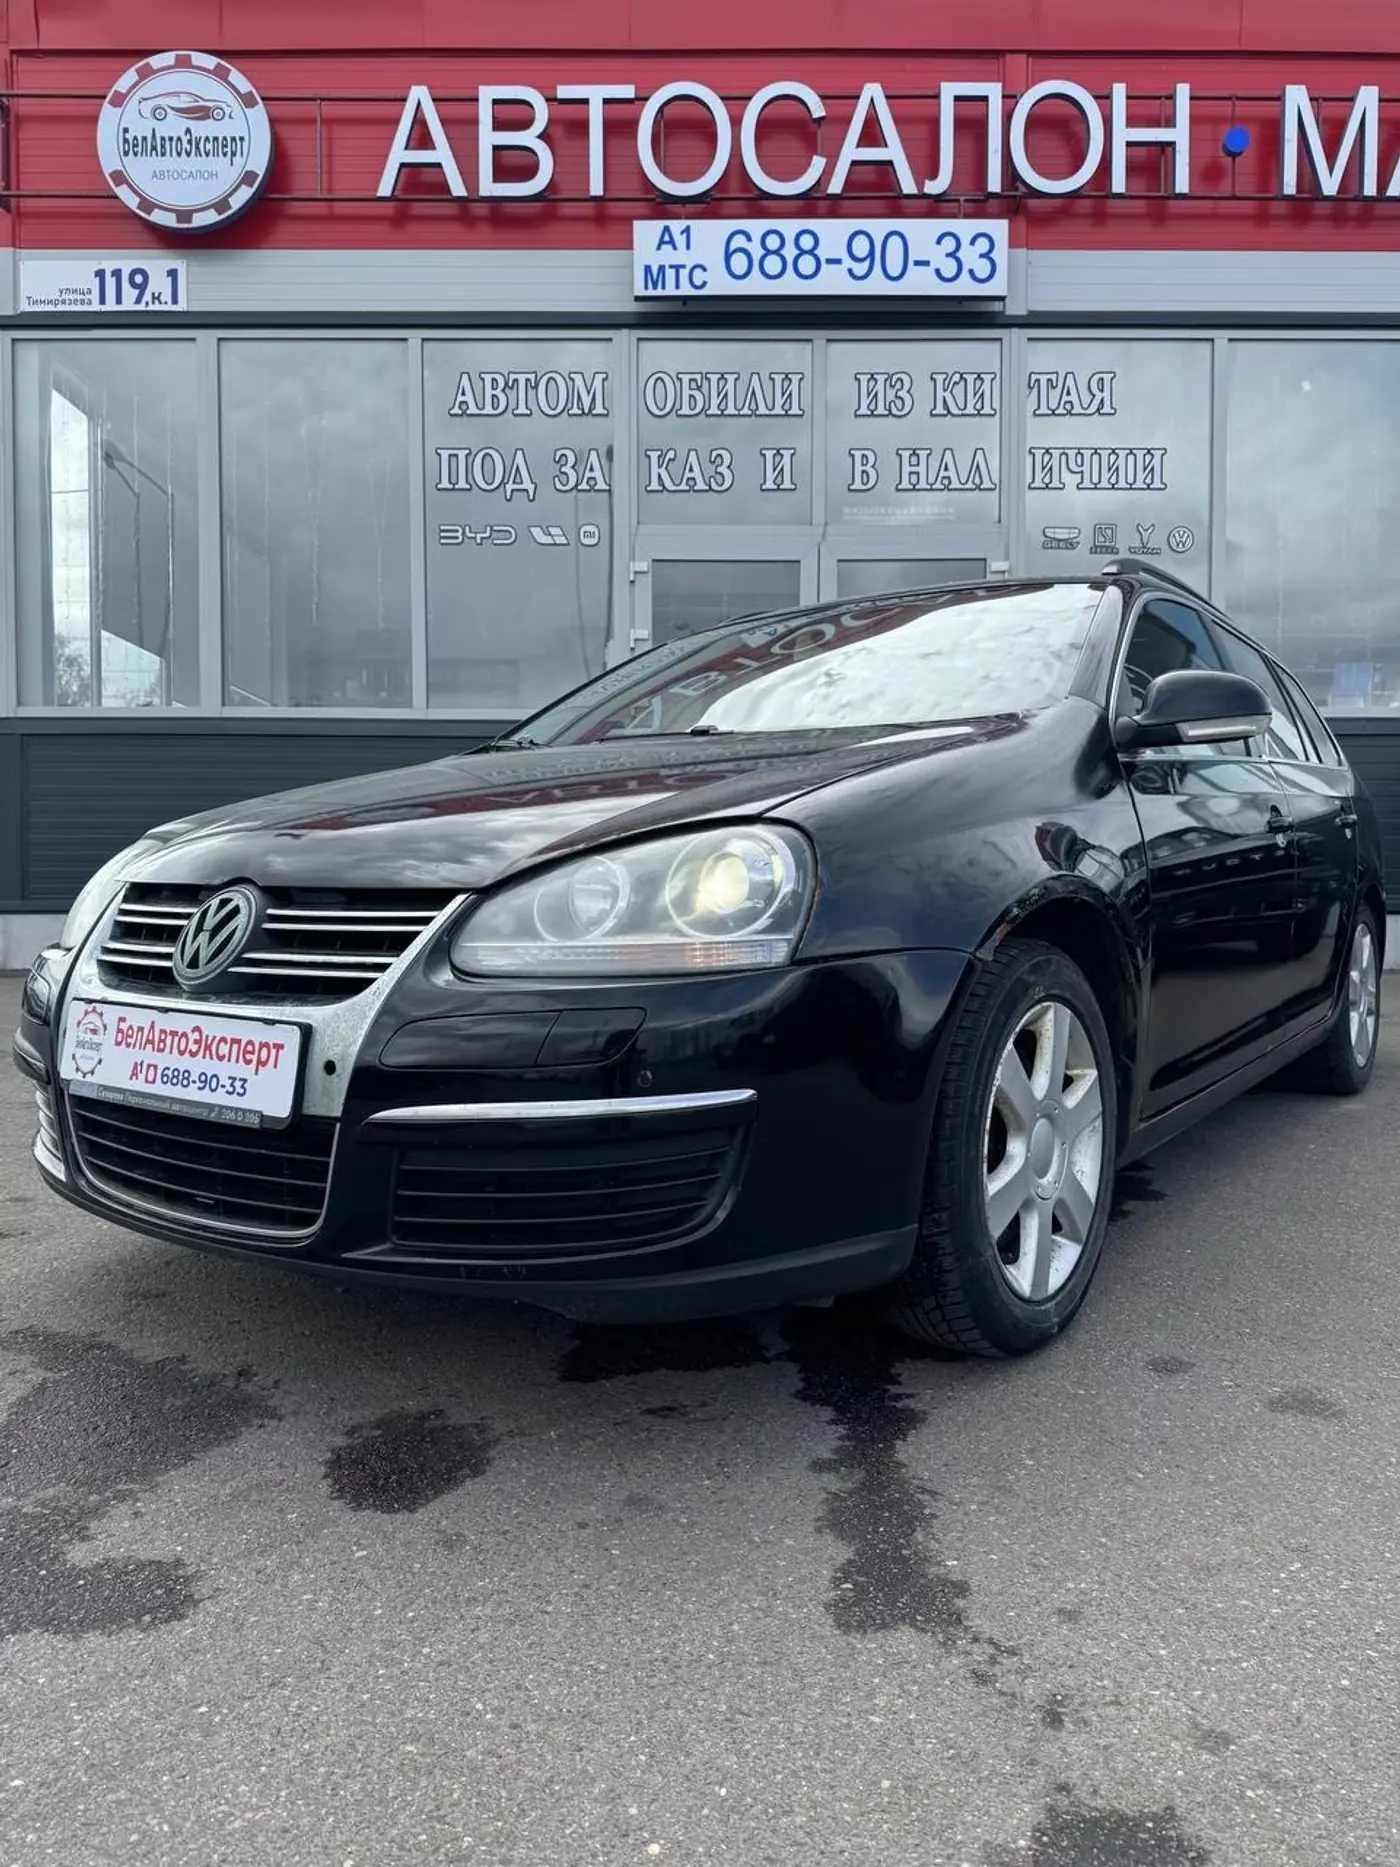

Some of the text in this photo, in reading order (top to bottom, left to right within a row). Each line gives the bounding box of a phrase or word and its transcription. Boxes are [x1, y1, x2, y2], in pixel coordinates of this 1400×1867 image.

[122, 126, 246, 167] БелАвтоЭксперт
[376, 80, 1400, 198] АВТОСАЛОН М
[151, 169, 219, 180] АВТОСАЛОН
[723, 228, 998, 284] 688-90-33
[58, 287, 92, 297] улица
[643, 263, 708, 291] МТС
[26, 296, 92, 308] Тимирязева
[854, 371, 914, 417] ИЗ
[435, 447, 537, 502] ПОД
[760, 448, 796, 491] И
[848, 448, 878, 492] В
[114, 1015, 285, 1076] БелАвтоЭксперт
[160, 1066, 249, 1098] 688-90-33
